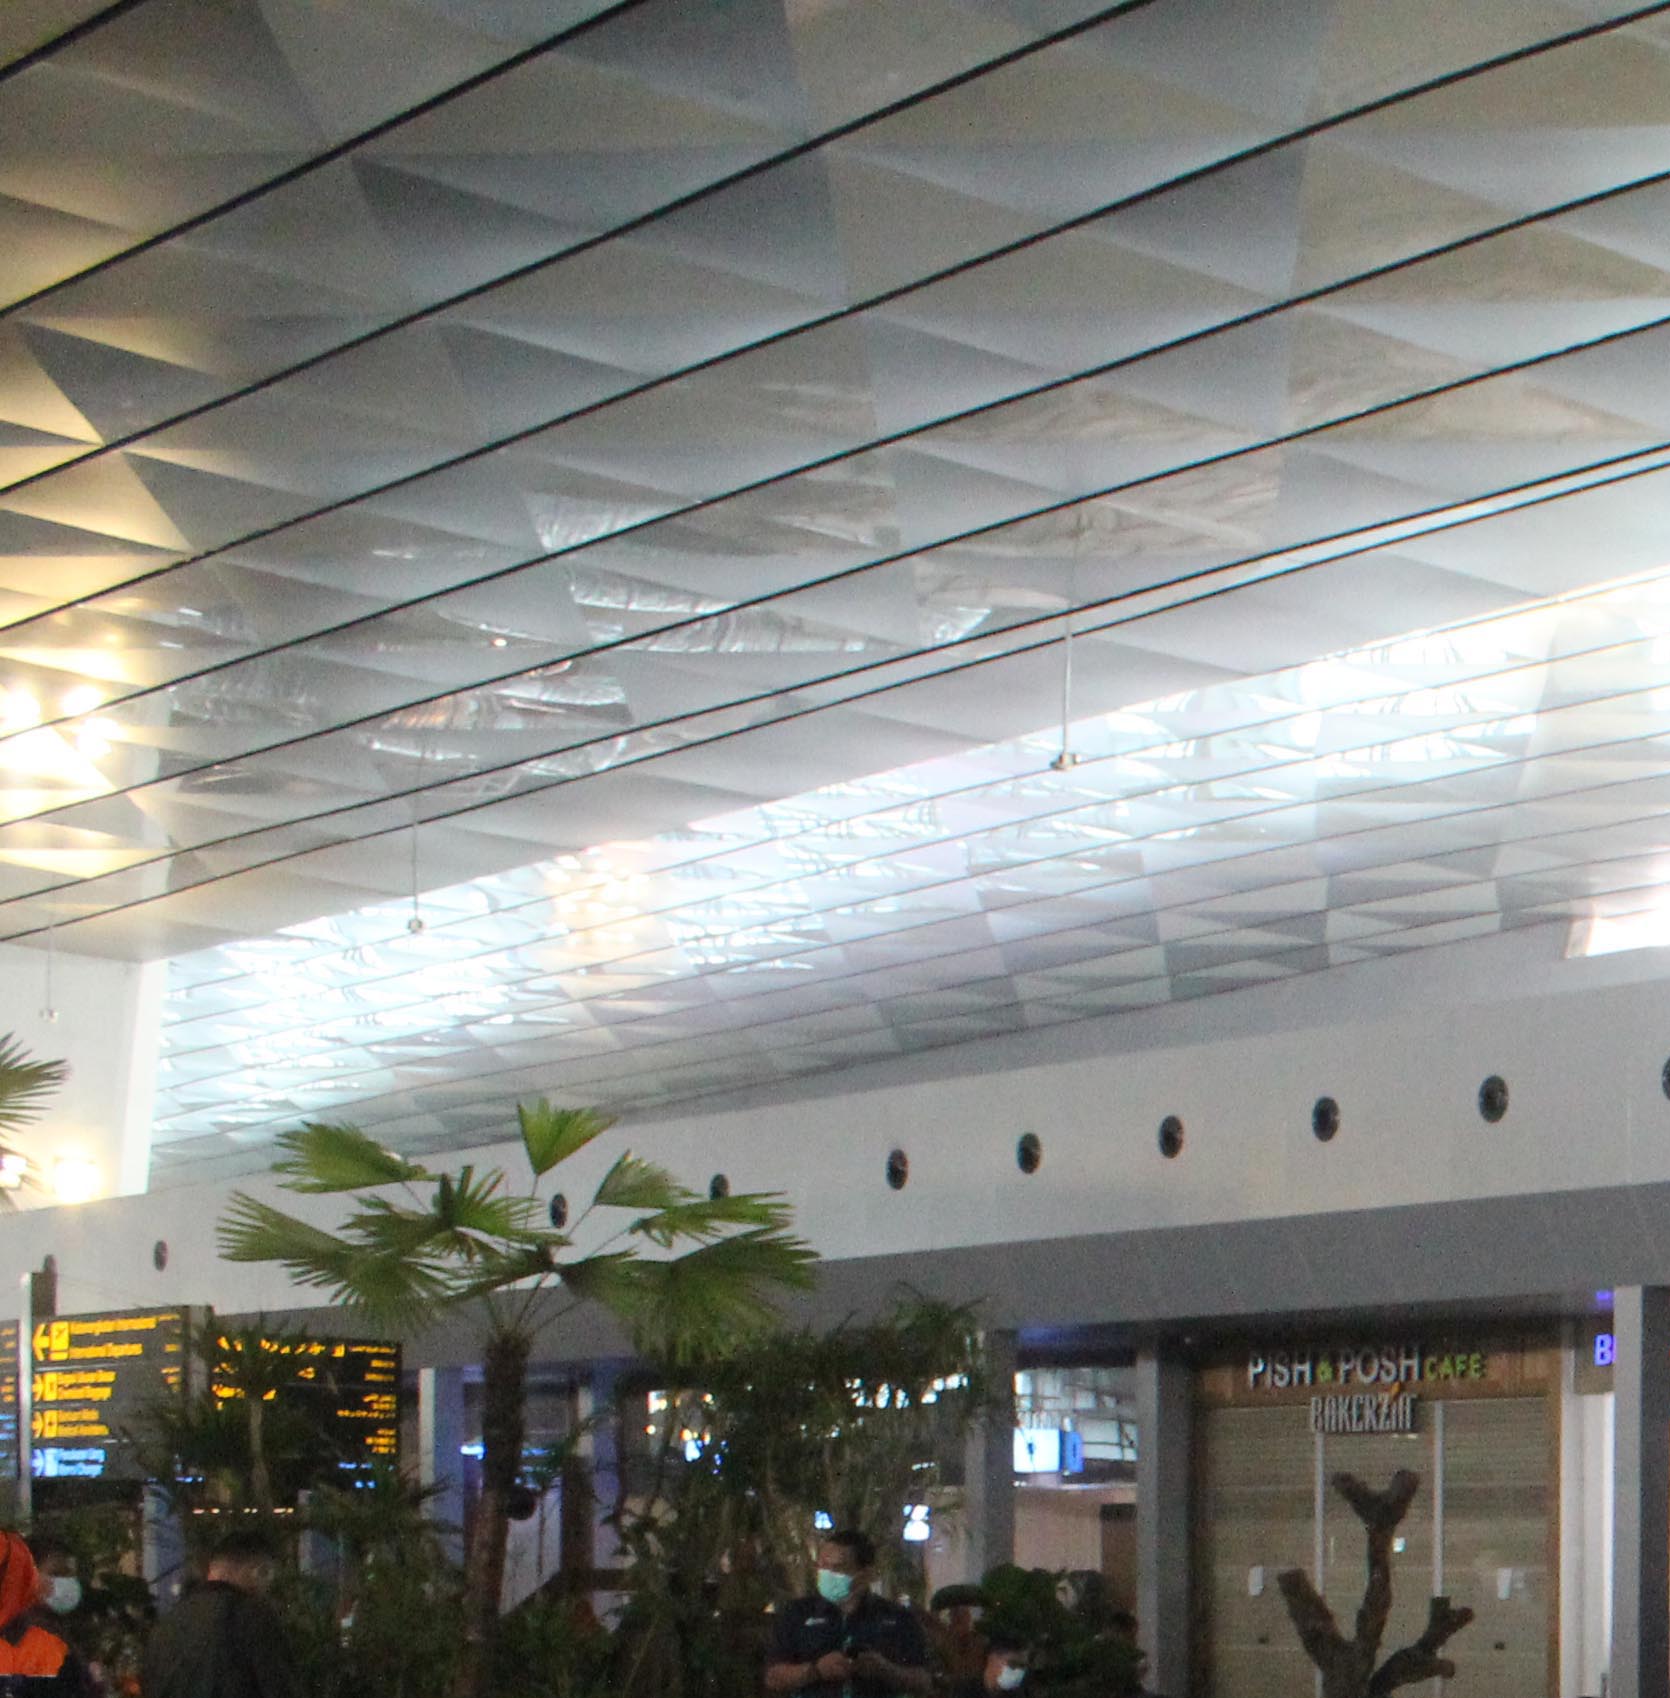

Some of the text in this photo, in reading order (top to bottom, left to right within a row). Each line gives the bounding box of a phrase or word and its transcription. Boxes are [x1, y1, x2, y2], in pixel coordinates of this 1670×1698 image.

[1248, 1351, 1312, 1388] PISH
[1339, 1346, 1420, 1386] POSH
[1425, 1352, 1487, 1381] CAFE
